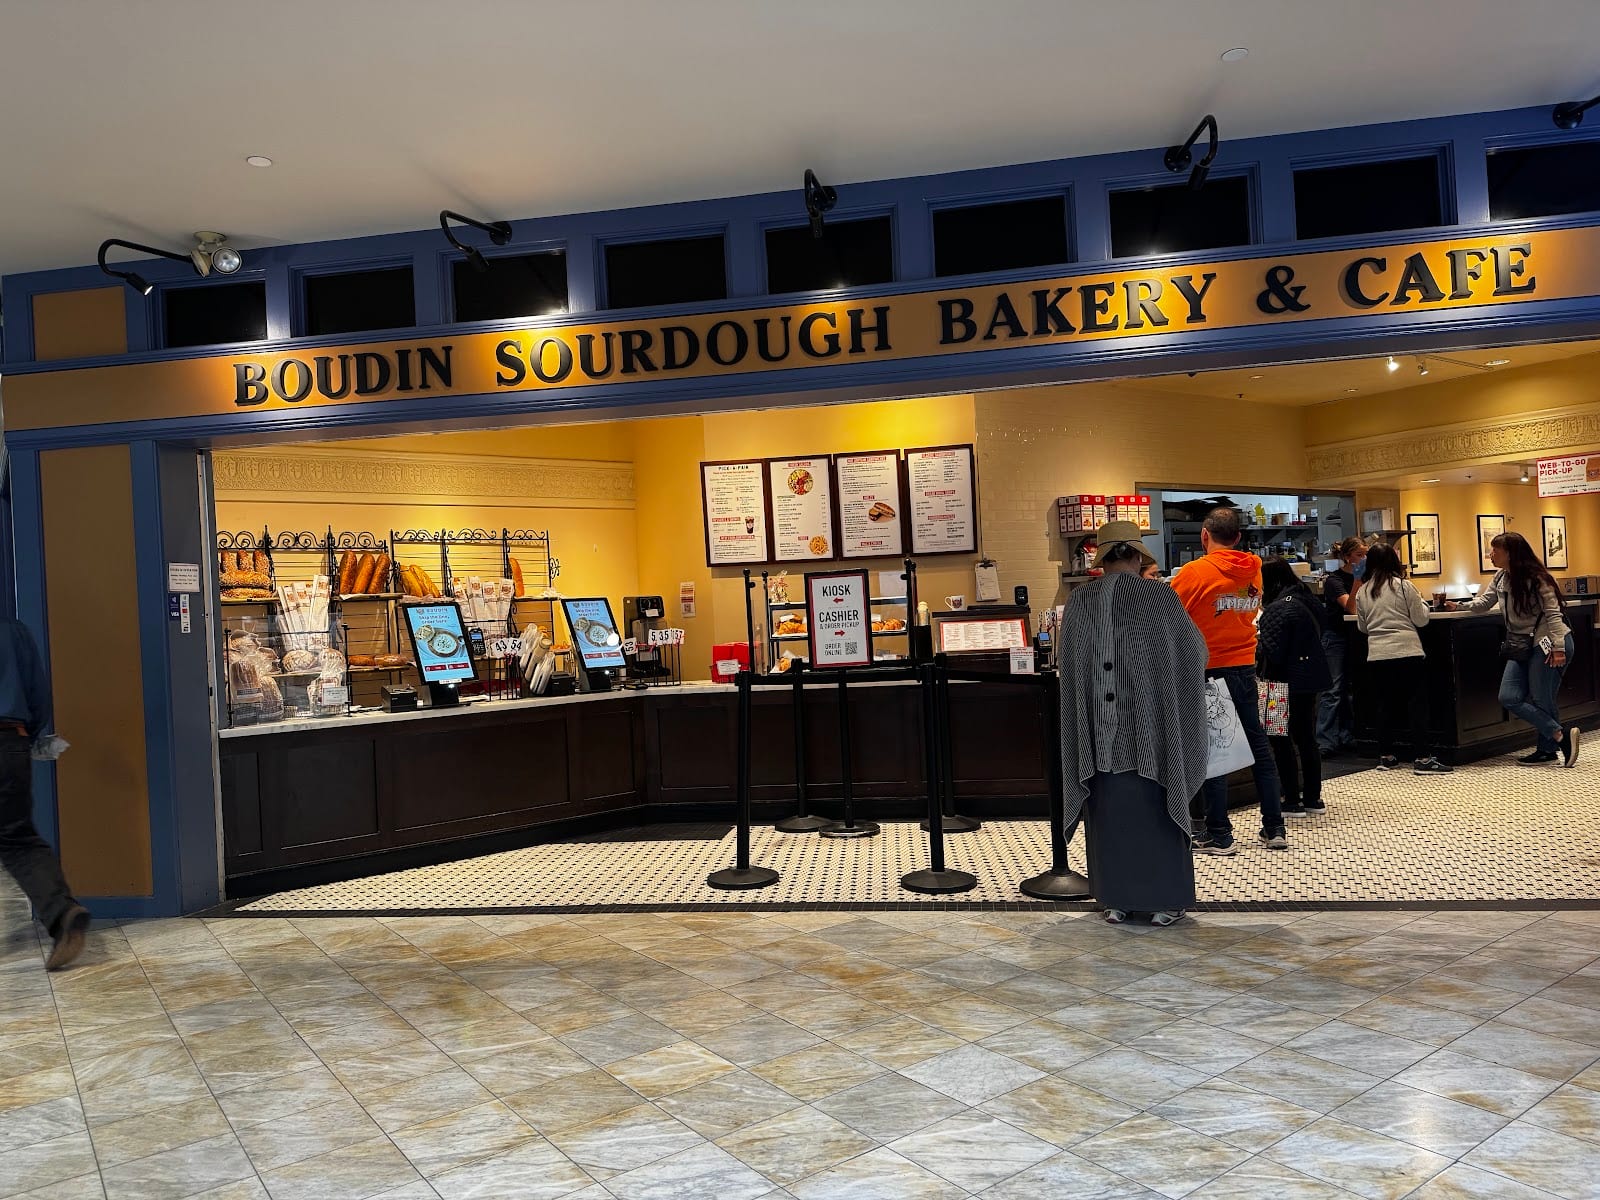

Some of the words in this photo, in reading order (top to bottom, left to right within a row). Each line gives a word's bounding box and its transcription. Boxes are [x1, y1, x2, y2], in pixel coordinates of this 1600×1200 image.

[233, 345, 453, 407] BOUDIN
[495, 305, 892, 387] SOURDOUGH
[938, 272, 1217, 345] BAKERY
[1256, 265, 1311, 314] &
[1344, 242, 1536, 307] CAFE
[1539, 459, 1586, 470] WEB-TO-GO
[1539, 467, 1573, 476] PICK-UP
[822, 584, 851, 597] KIOSK
[819, 609, 859, 622] CASHIER
[841, 621, 860, 629] PICKUP
[495, 639, 508, 652] 43
[510, 639, 522, 651] 54
[625, 641, 634, 652] 53
